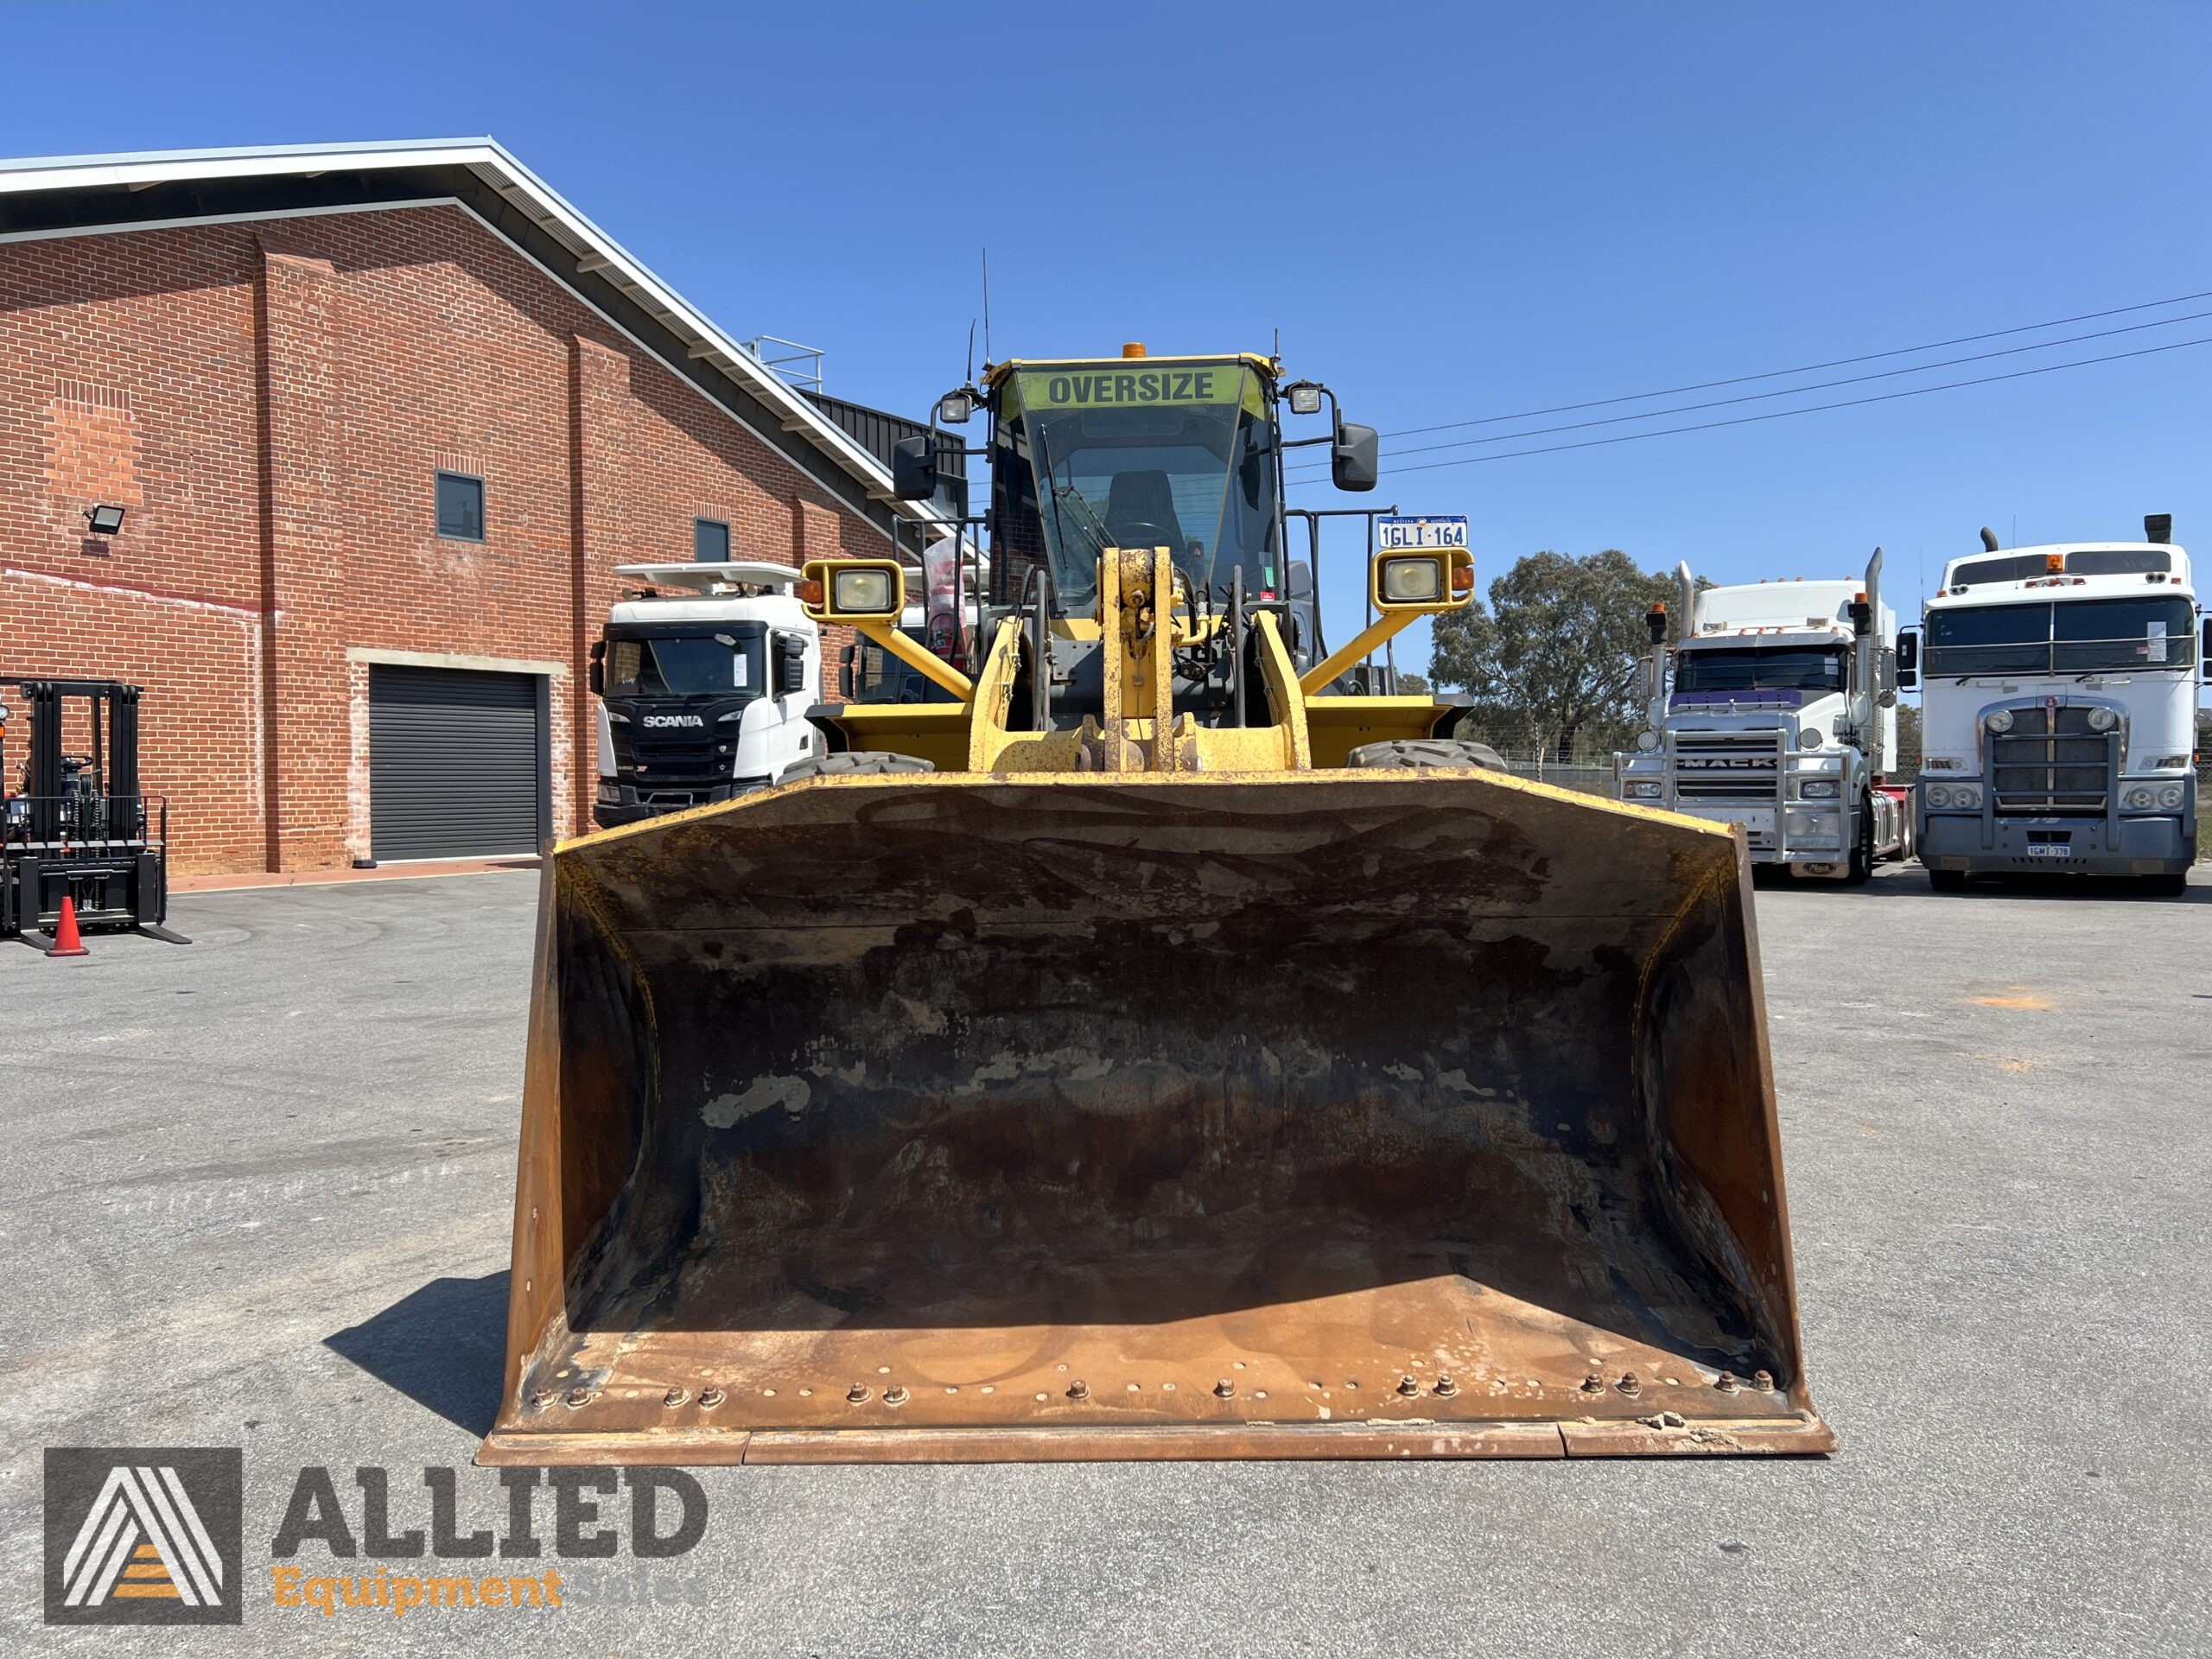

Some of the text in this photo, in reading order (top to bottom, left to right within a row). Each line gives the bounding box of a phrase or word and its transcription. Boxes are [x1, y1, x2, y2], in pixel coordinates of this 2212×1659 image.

[1049, 372, 1214, 404] OVERSIZE
[643, 715, 704, 728] SCANIA
[1684, 759, 1775, 768] MACK
